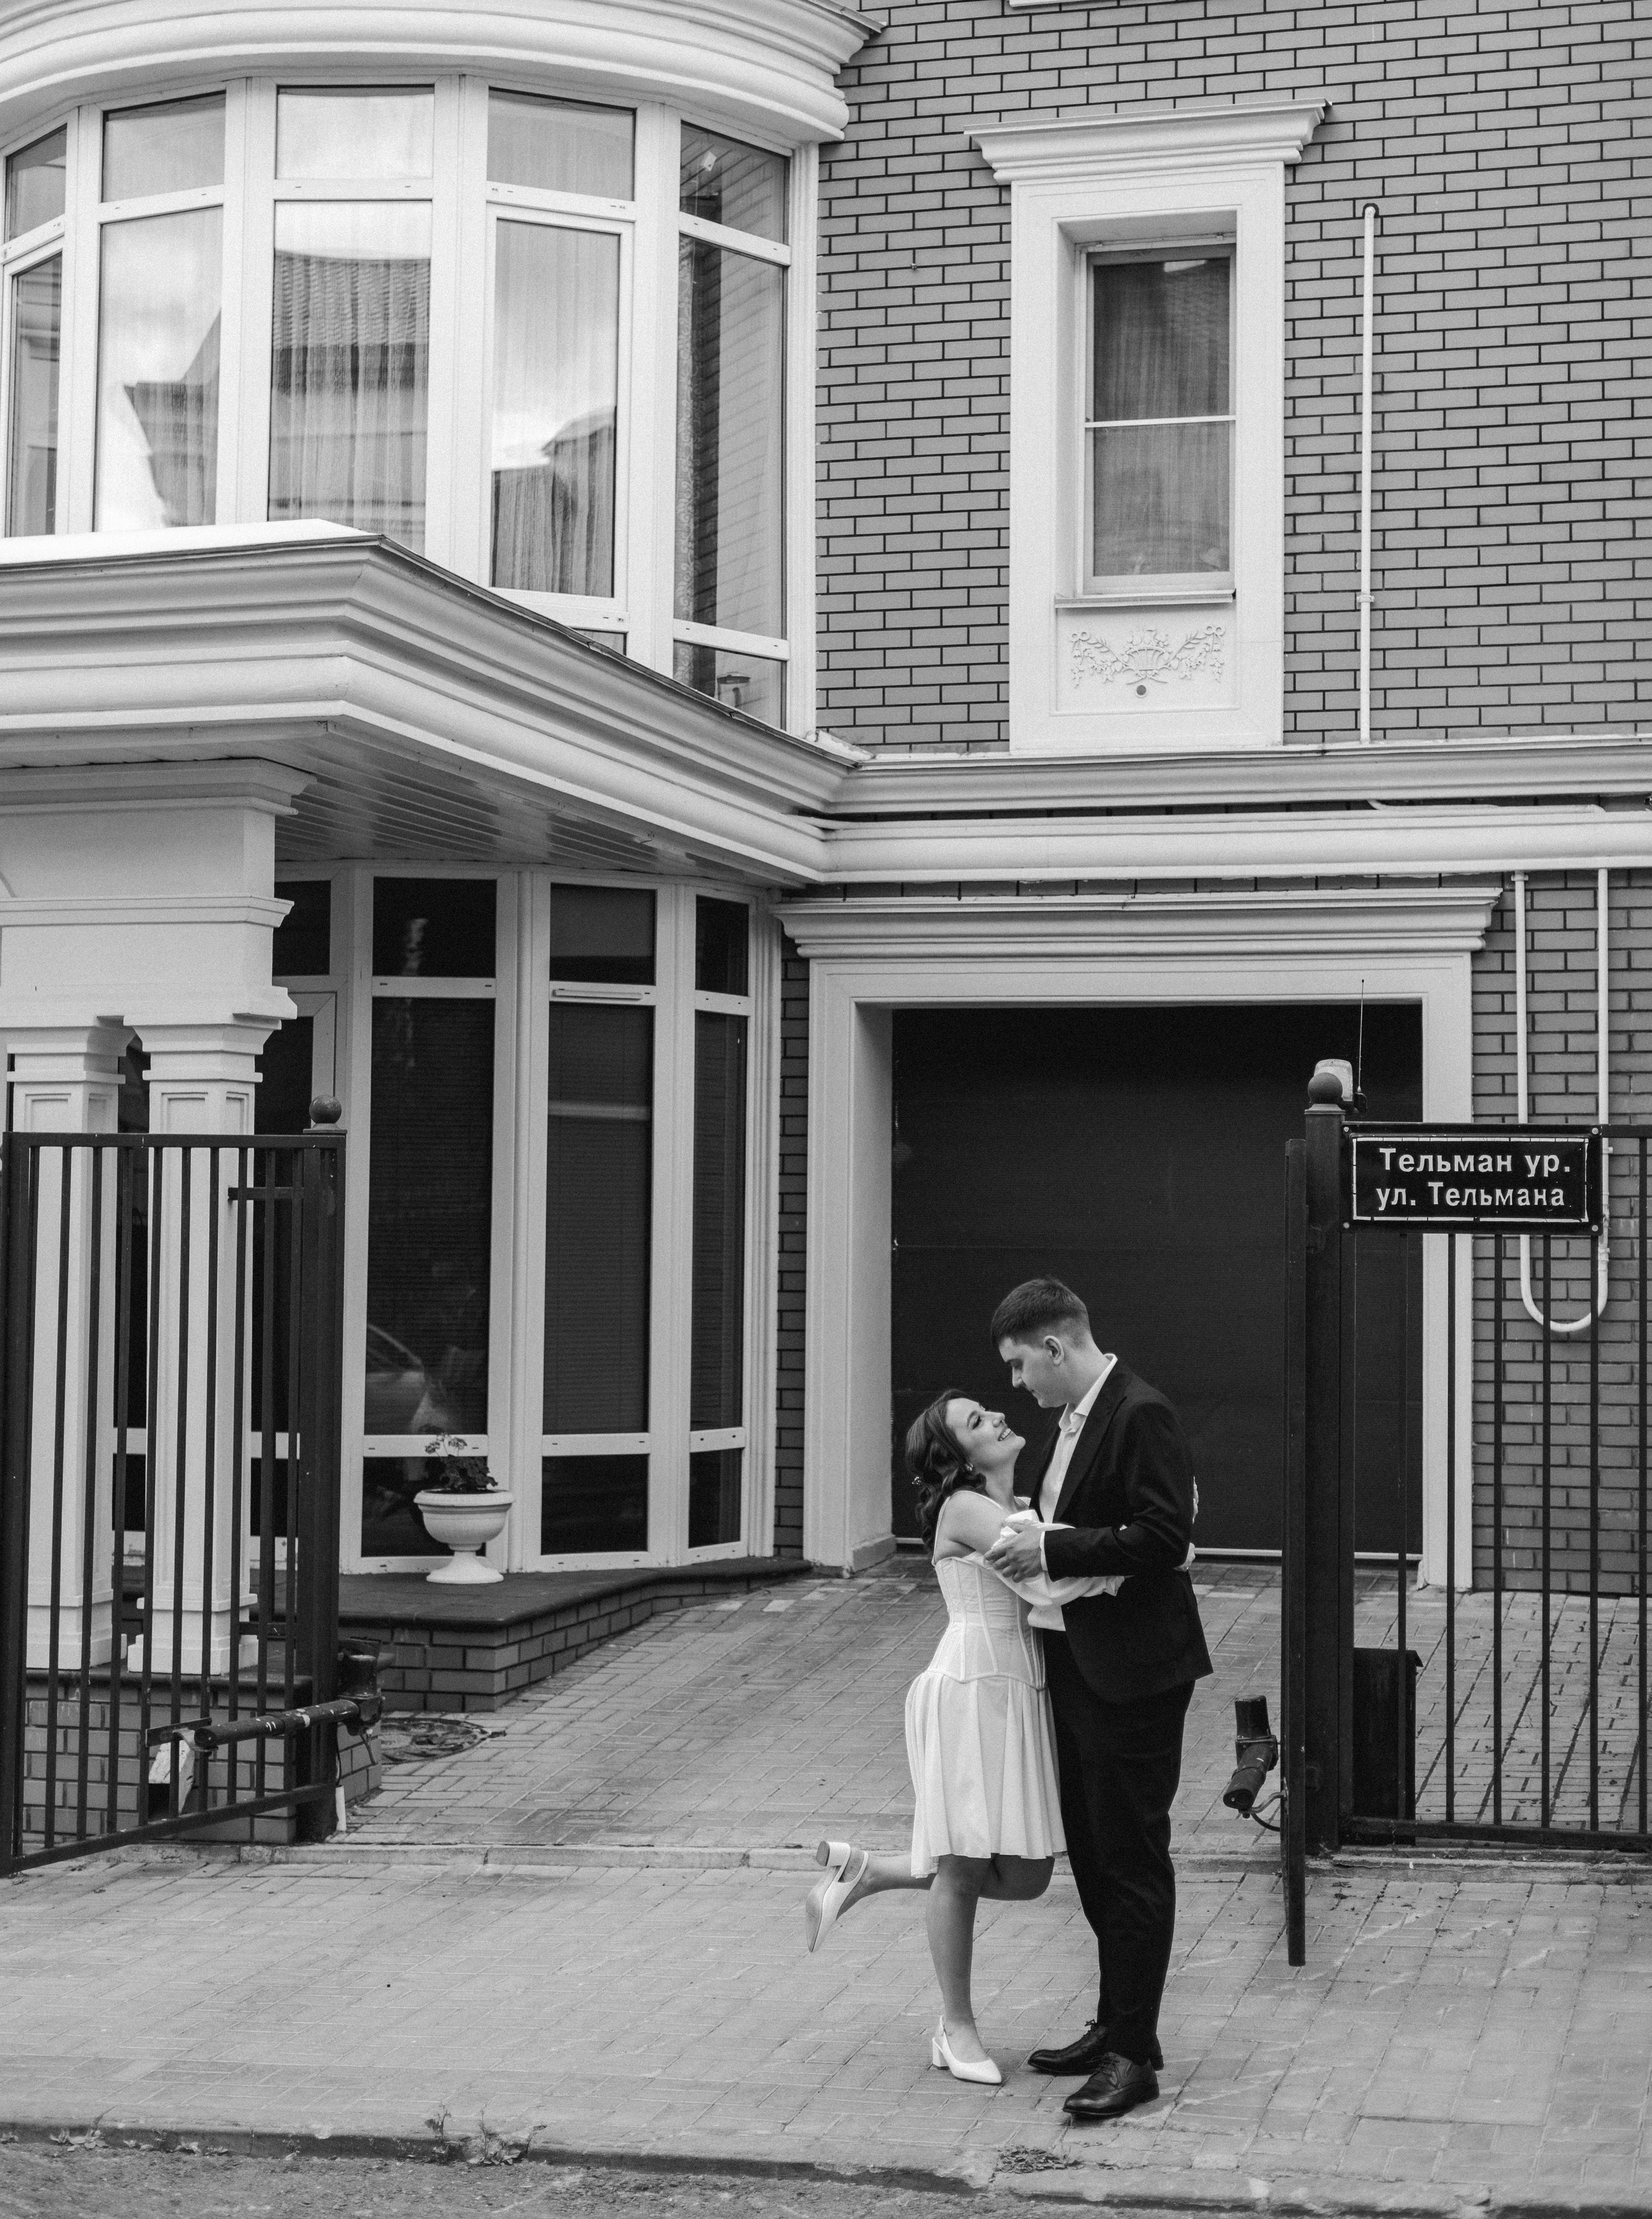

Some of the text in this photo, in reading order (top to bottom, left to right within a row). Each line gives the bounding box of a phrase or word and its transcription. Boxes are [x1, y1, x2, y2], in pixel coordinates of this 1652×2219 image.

[1379, 1147, 1570, 1178] Тельман ур.
[1376, 1181, 1565, 1211] ул. Тельмана
